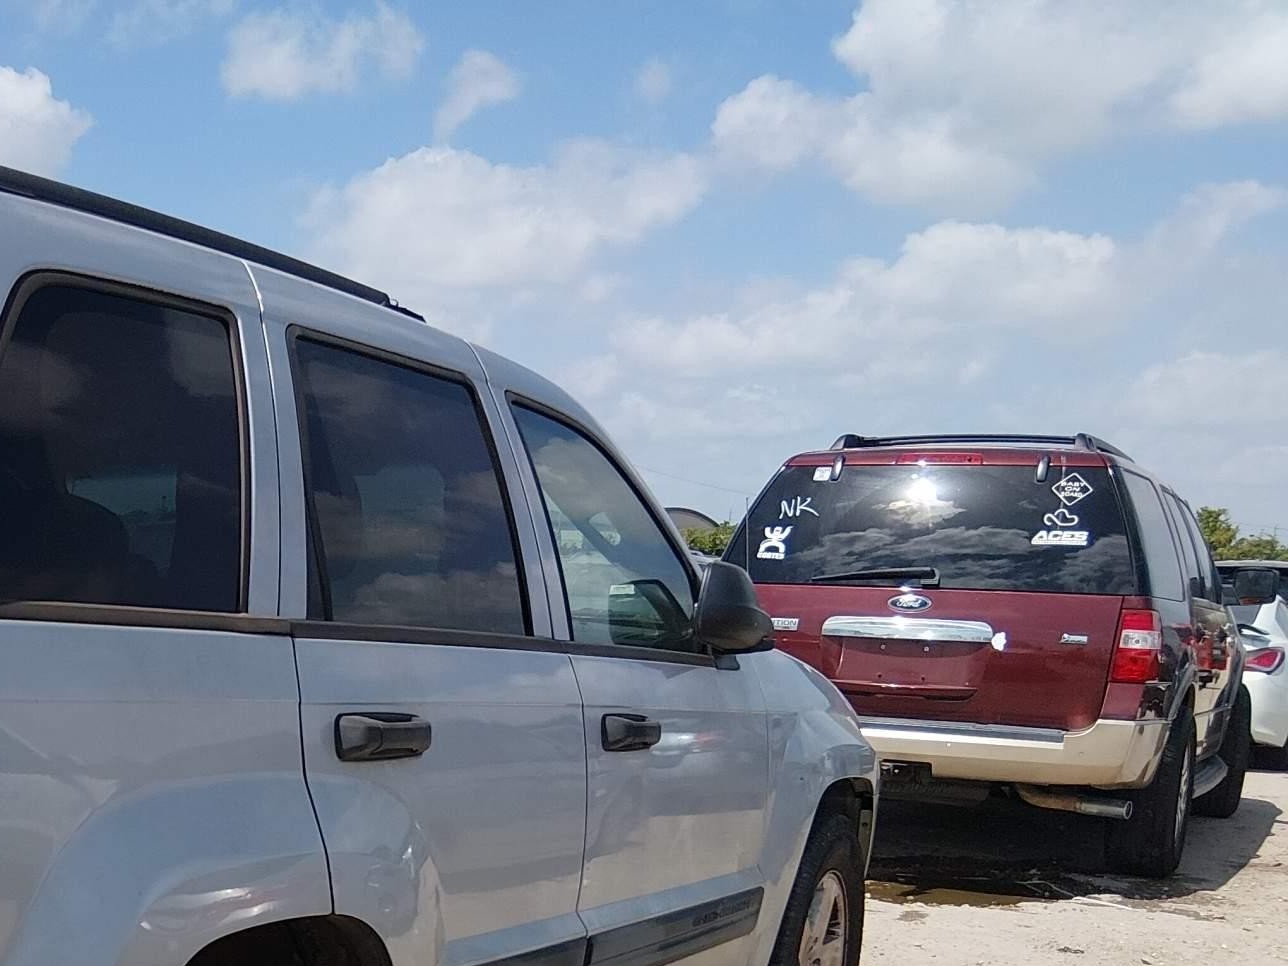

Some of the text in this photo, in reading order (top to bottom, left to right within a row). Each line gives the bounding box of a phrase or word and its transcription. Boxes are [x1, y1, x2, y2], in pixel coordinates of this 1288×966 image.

[779, 496, 820, 519] NK
[1031, 530, 1089, 541] ACES
[895, 597, 922, 608] Ford
